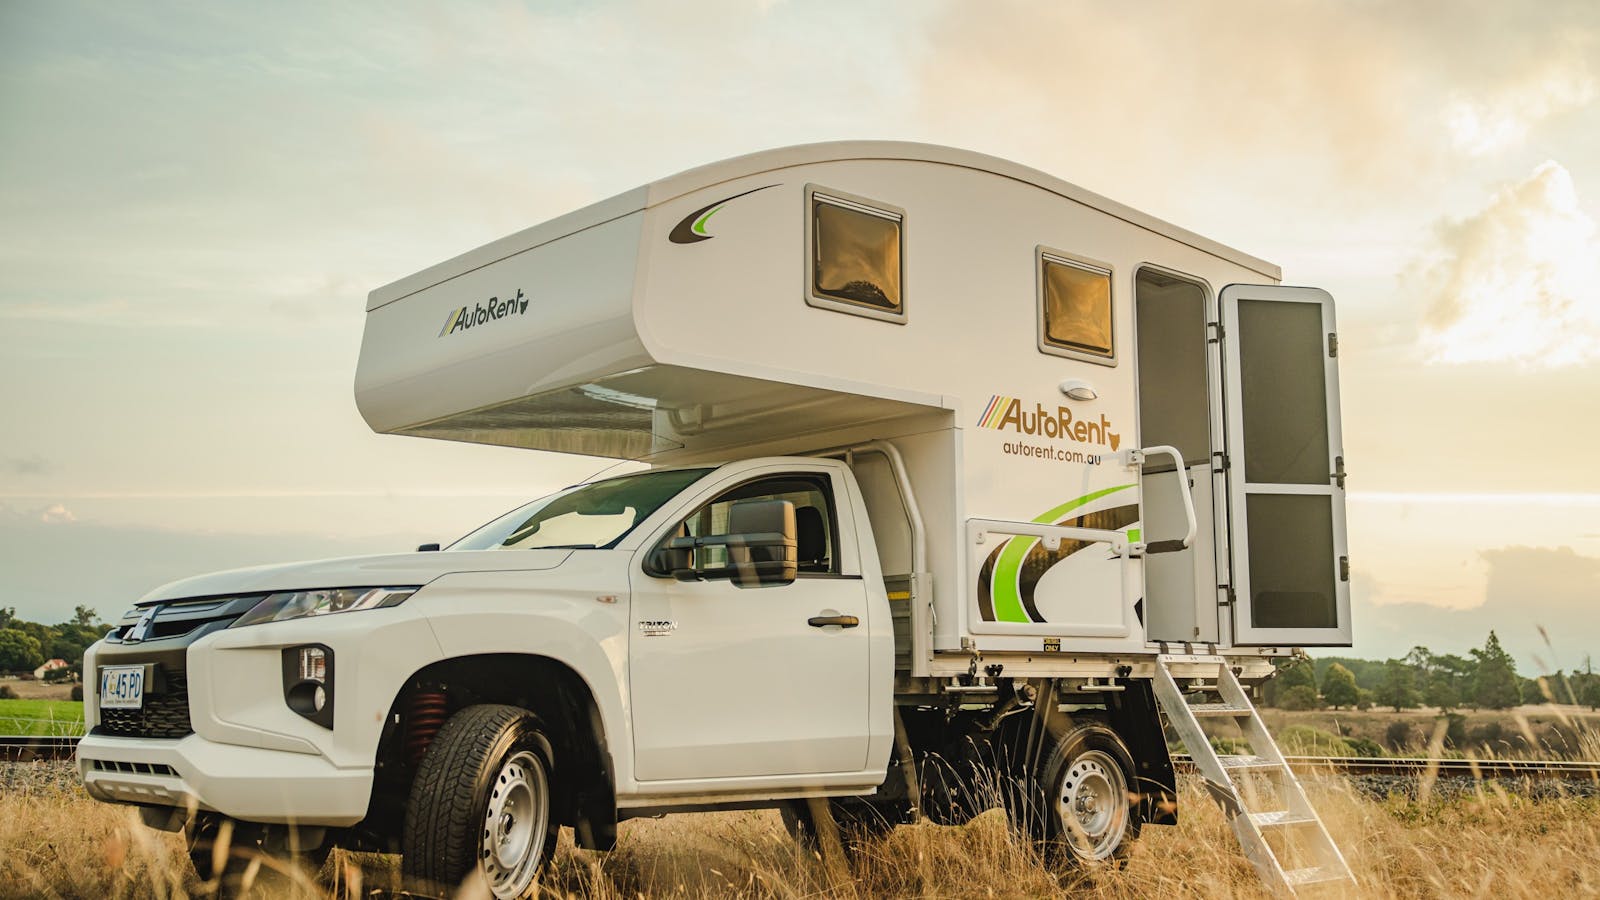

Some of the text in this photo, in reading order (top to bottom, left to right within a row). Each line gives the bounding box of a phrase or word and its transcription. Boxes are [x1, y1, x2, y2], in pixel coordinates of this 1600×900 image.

[449, 288, 524, 334] AutoRent
[997, 398, 1111, 446] AutoRent
[1003, 441, 1101, 466] autorent.com.au
[638, 620, 678, 631] TRITON
[102, 672, 141, 699] K 45 PD
